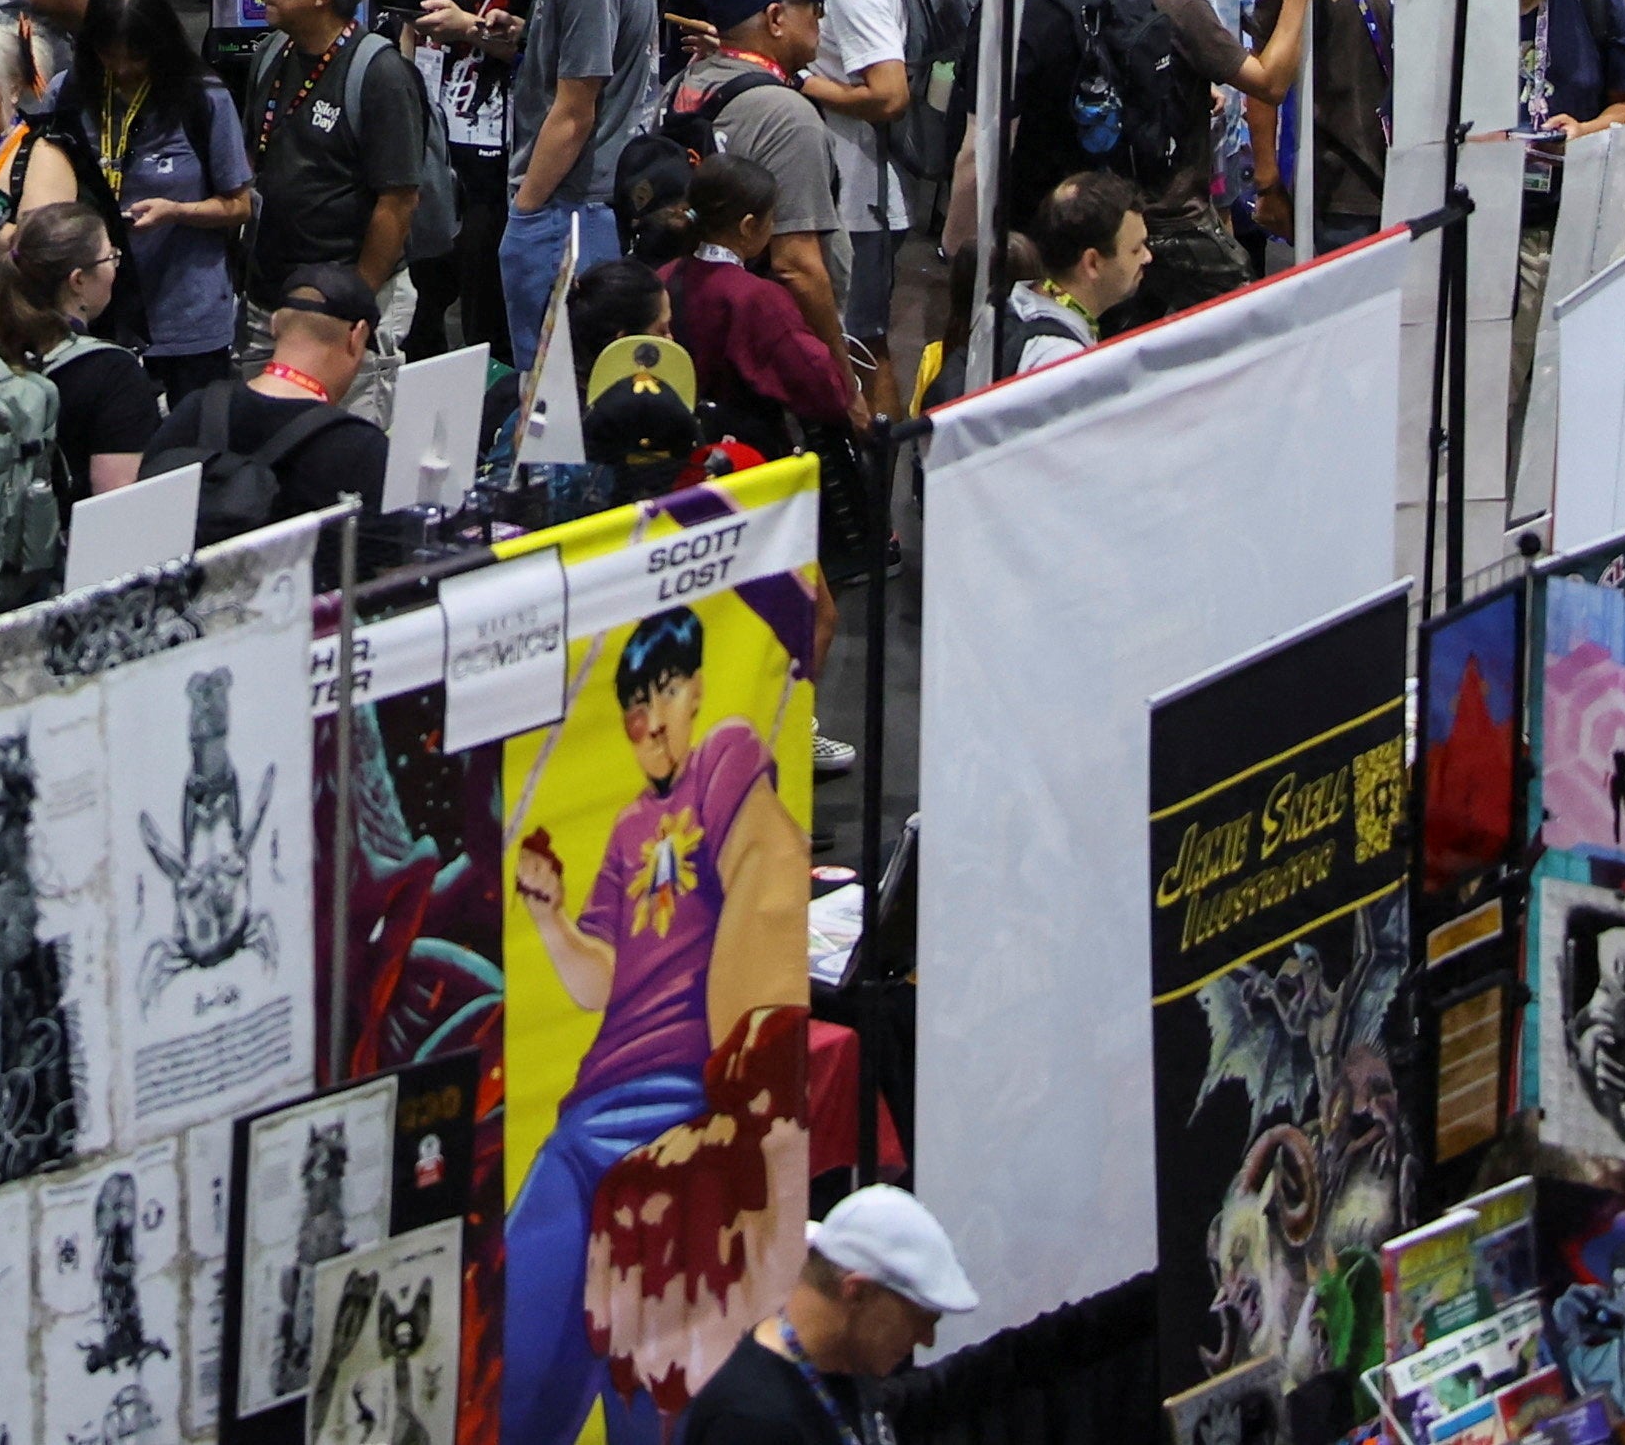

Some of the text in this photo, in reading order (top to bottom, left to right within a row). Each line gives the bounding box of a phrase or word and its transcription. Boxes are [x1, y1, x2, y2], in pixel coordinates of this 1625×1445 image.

[647, 519, 750, 575] SCOTT
[656, 555, 736, 602] LOST
[452, 623, 561, 682] COMICS
[1155, 764, 1350, 909] JAMIE SNELL
[1181, 837, 1337, 950] ILLUSTRATOR
